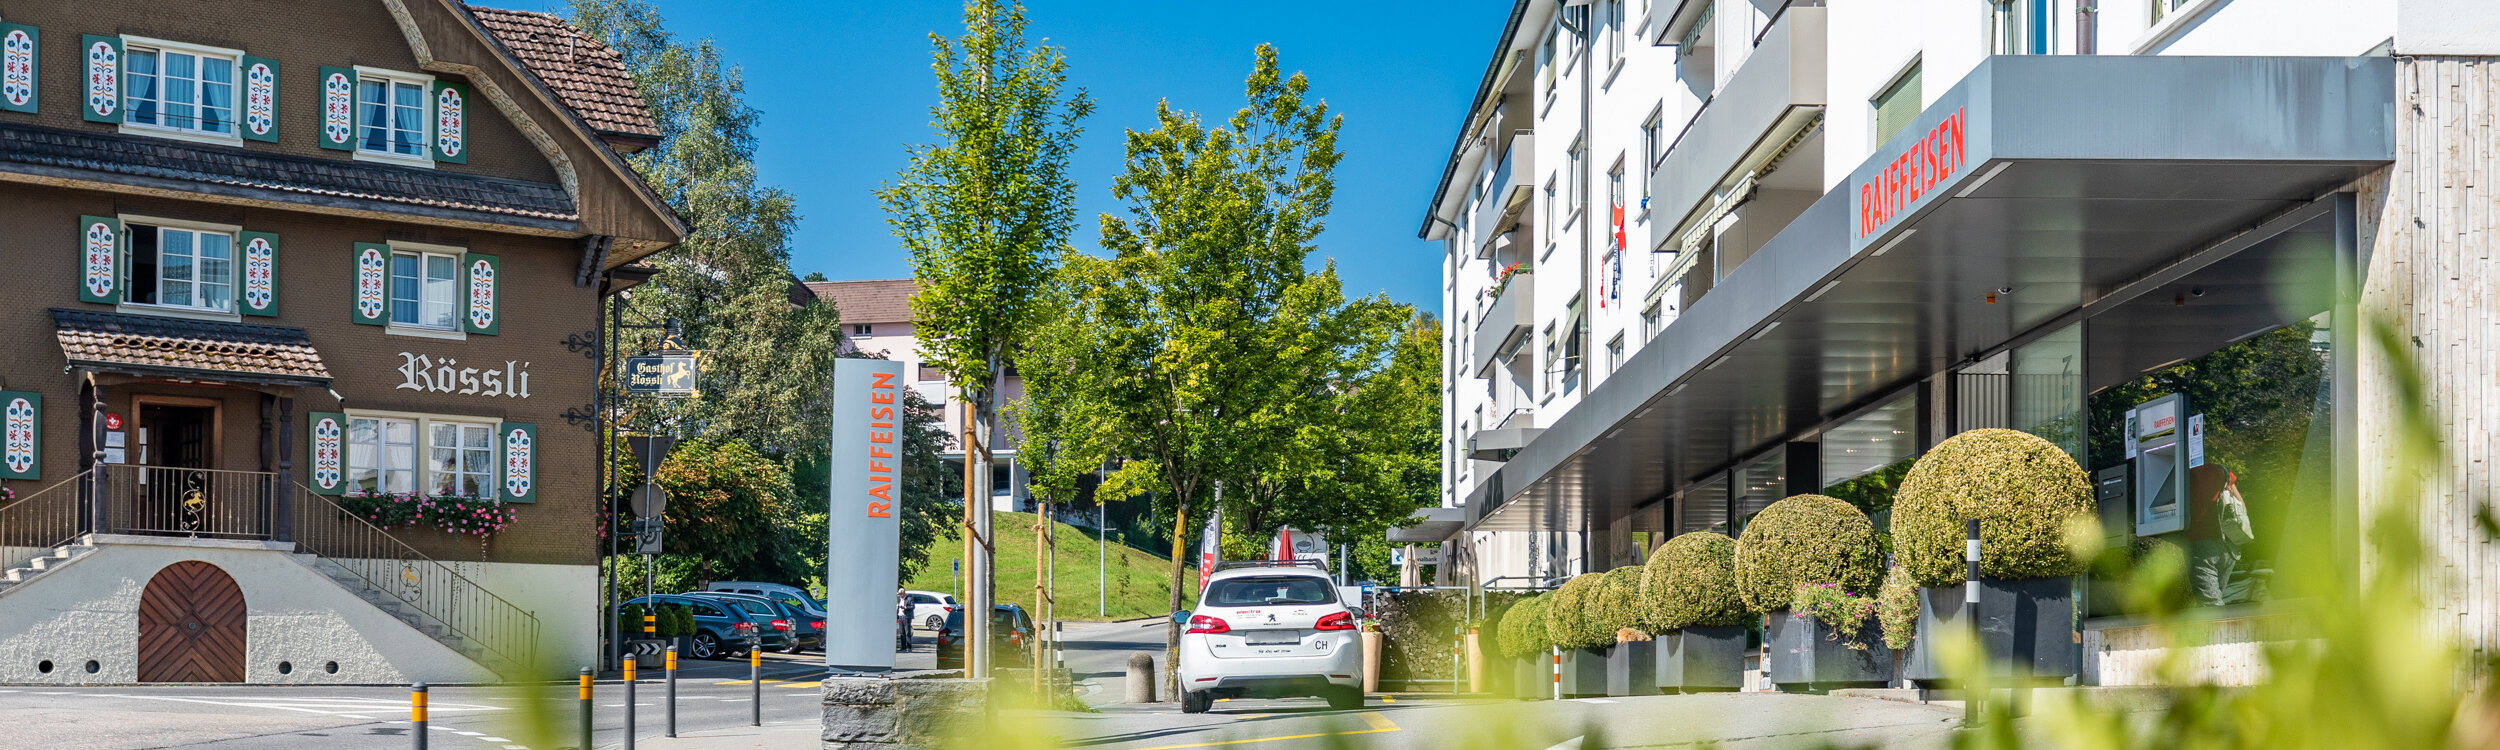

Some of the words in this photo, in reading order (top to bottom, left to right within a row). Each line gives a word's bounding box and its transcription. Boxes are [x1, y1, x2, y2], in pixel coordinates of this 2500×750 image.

[1860, 105, 1964, 239] RAIFFEISEN
[636, 361, 675, 374] Gasthof
[396, 351, 531, 399] Rössli
[630, 373, 663, 387] Rössli
[2153, 416, 2175, 429] RAIFFEISEN
[867, 372, 895, 518] RAIFFEISEN
[1314, 640, 1328, 650] CH
